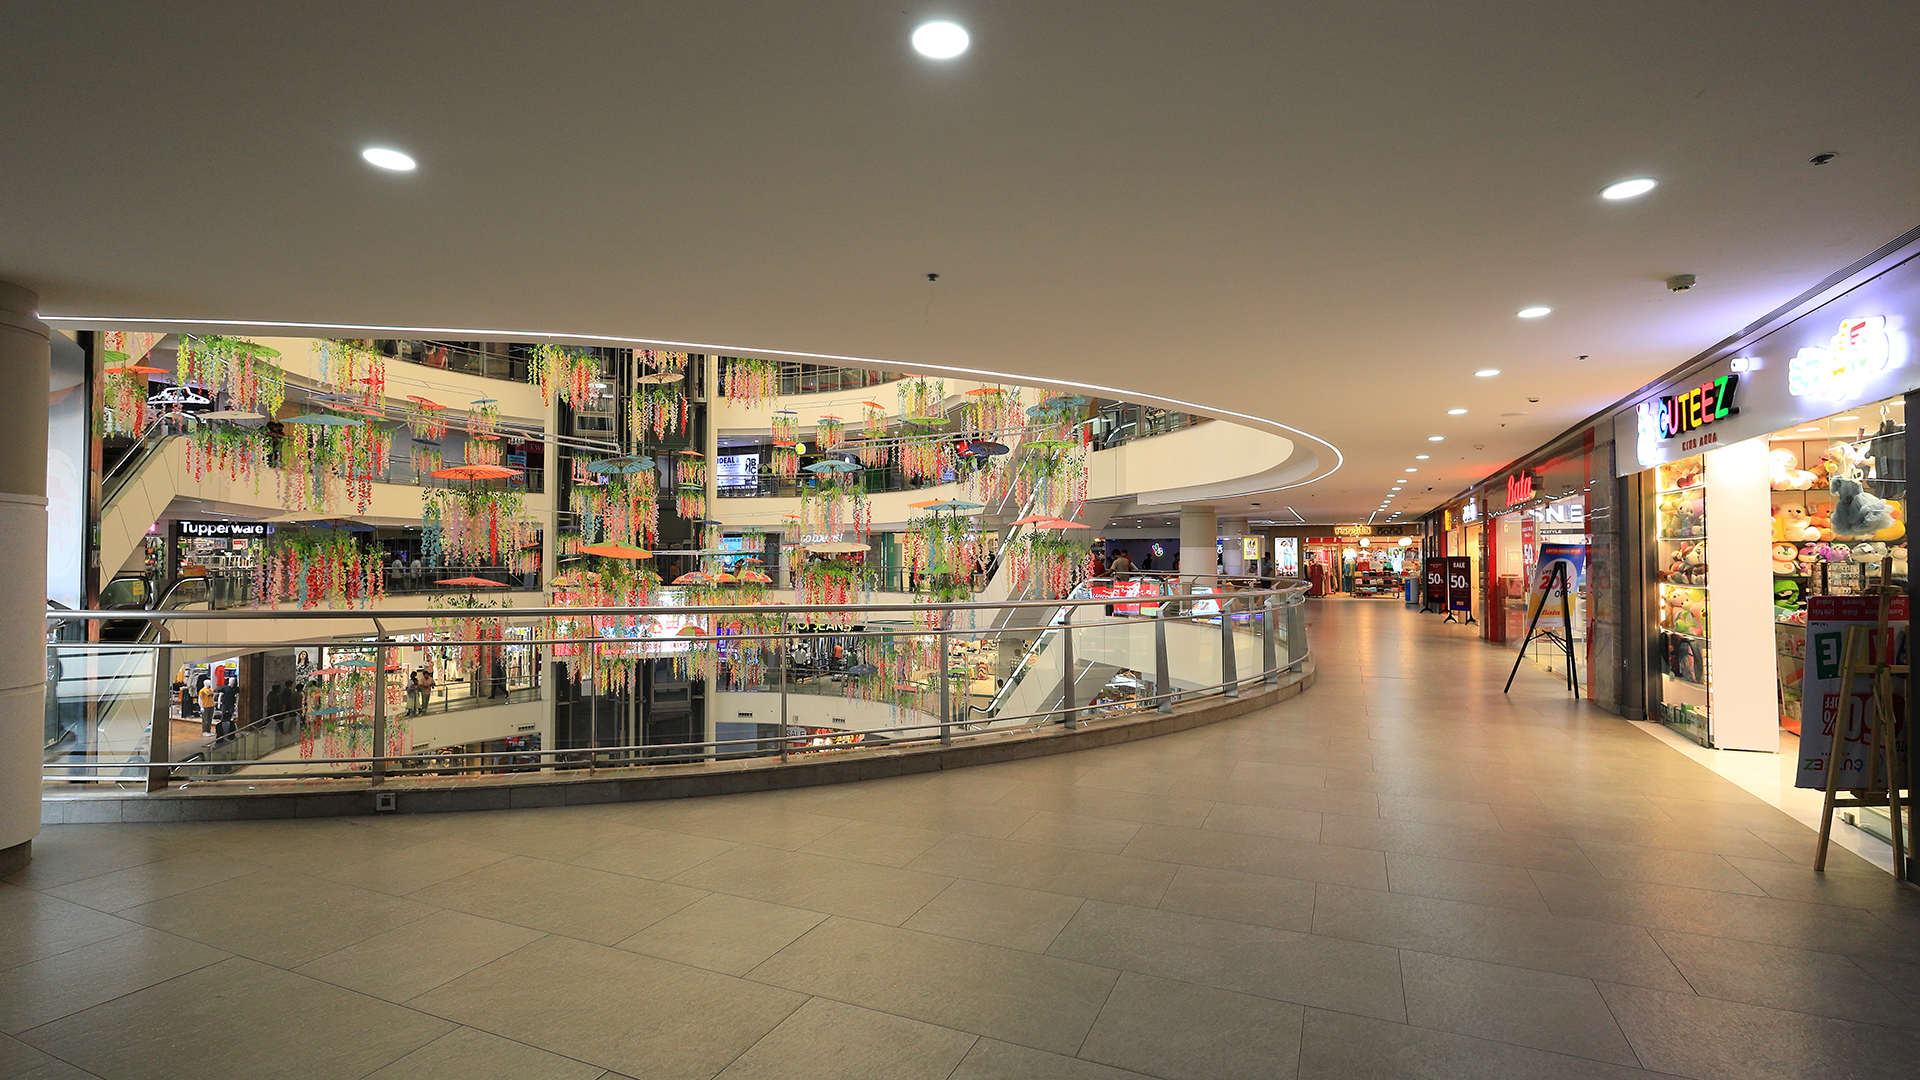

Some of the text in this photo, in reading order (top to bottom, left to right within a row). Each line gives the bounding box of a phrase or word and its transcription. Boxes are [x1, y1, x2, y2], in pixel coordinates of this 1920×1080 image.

[1658, 375, 1729, 439] CUTEEZ
[1682, 438, 1697, 451] KIDS
[1505, 469, 1533, 507] Bata
[180, 521, 264, 536] Tupperware
